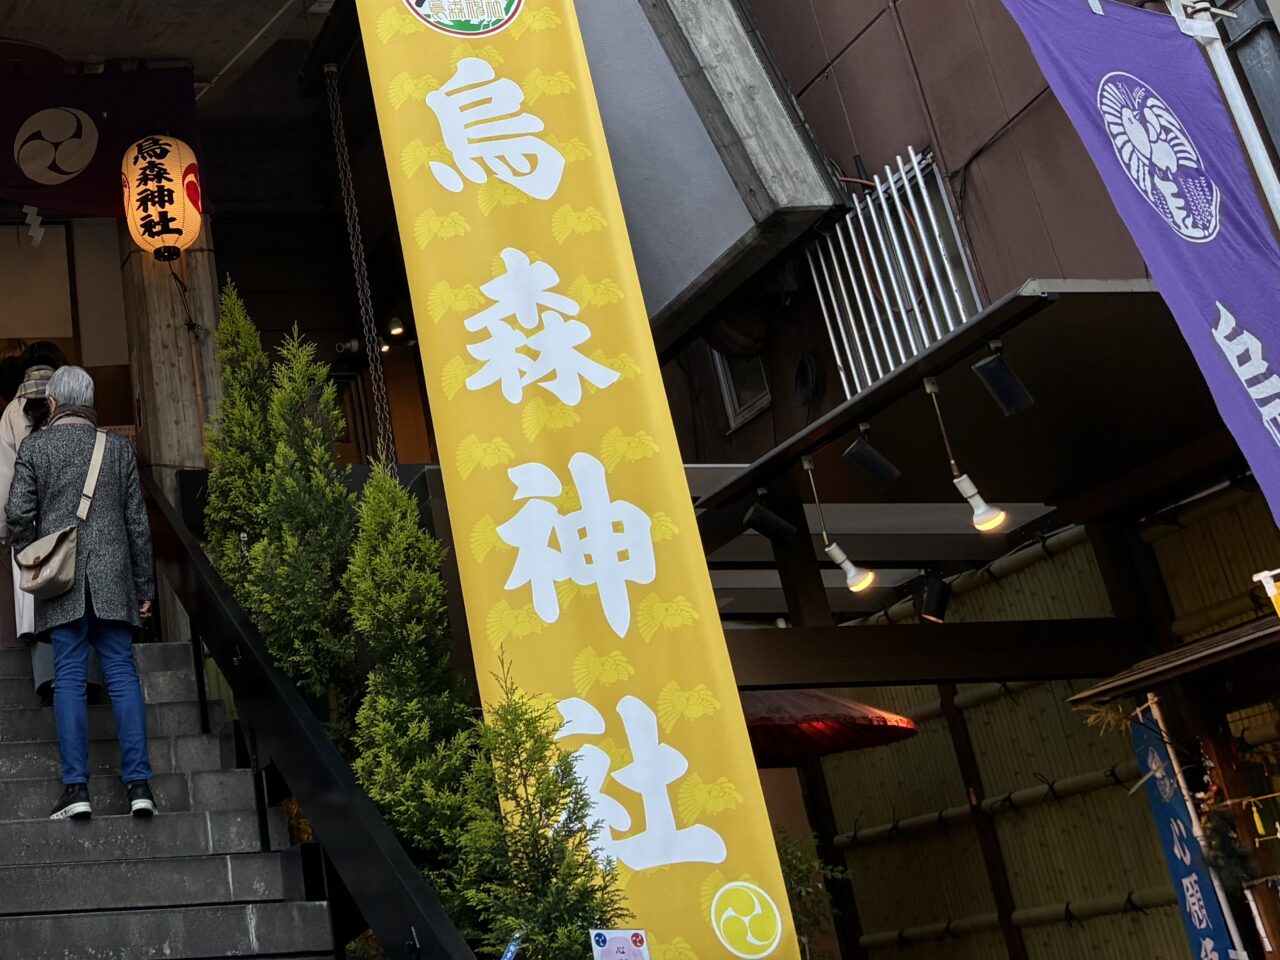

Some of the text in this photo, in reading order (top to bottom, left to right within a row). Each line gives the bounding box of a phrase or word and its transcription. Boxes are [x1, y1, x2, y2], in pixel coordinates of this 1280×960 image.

[132, 136, 183, 239] 烏森神社
[426, 58, 727, 871] 烏森神社
